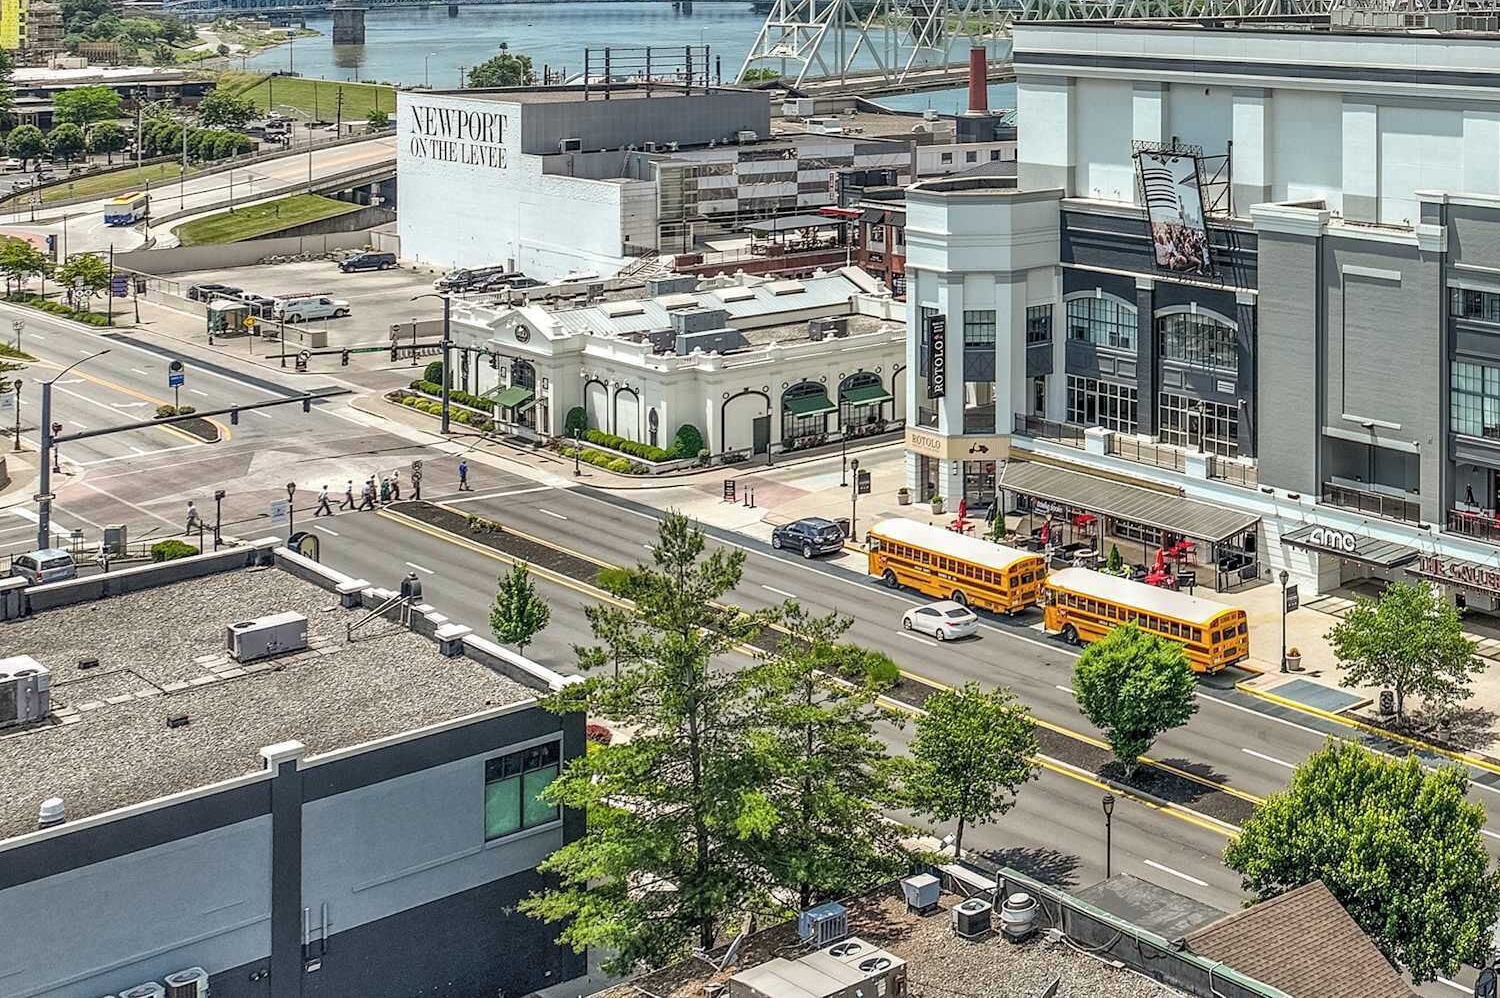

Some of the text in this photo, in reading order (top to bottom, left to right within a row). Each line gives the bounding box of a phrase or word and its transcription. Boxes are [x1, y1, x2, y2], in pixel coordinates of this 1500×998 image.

[411, 105, 507, 143] NEWPORT
[411, 136, 508, 170] ON THE LEVEE
[934, 340, 944, 393] ROTOLO
[911, 433, 941, 450] ROTOLO
[1420, 556, 1446, 575] THE
